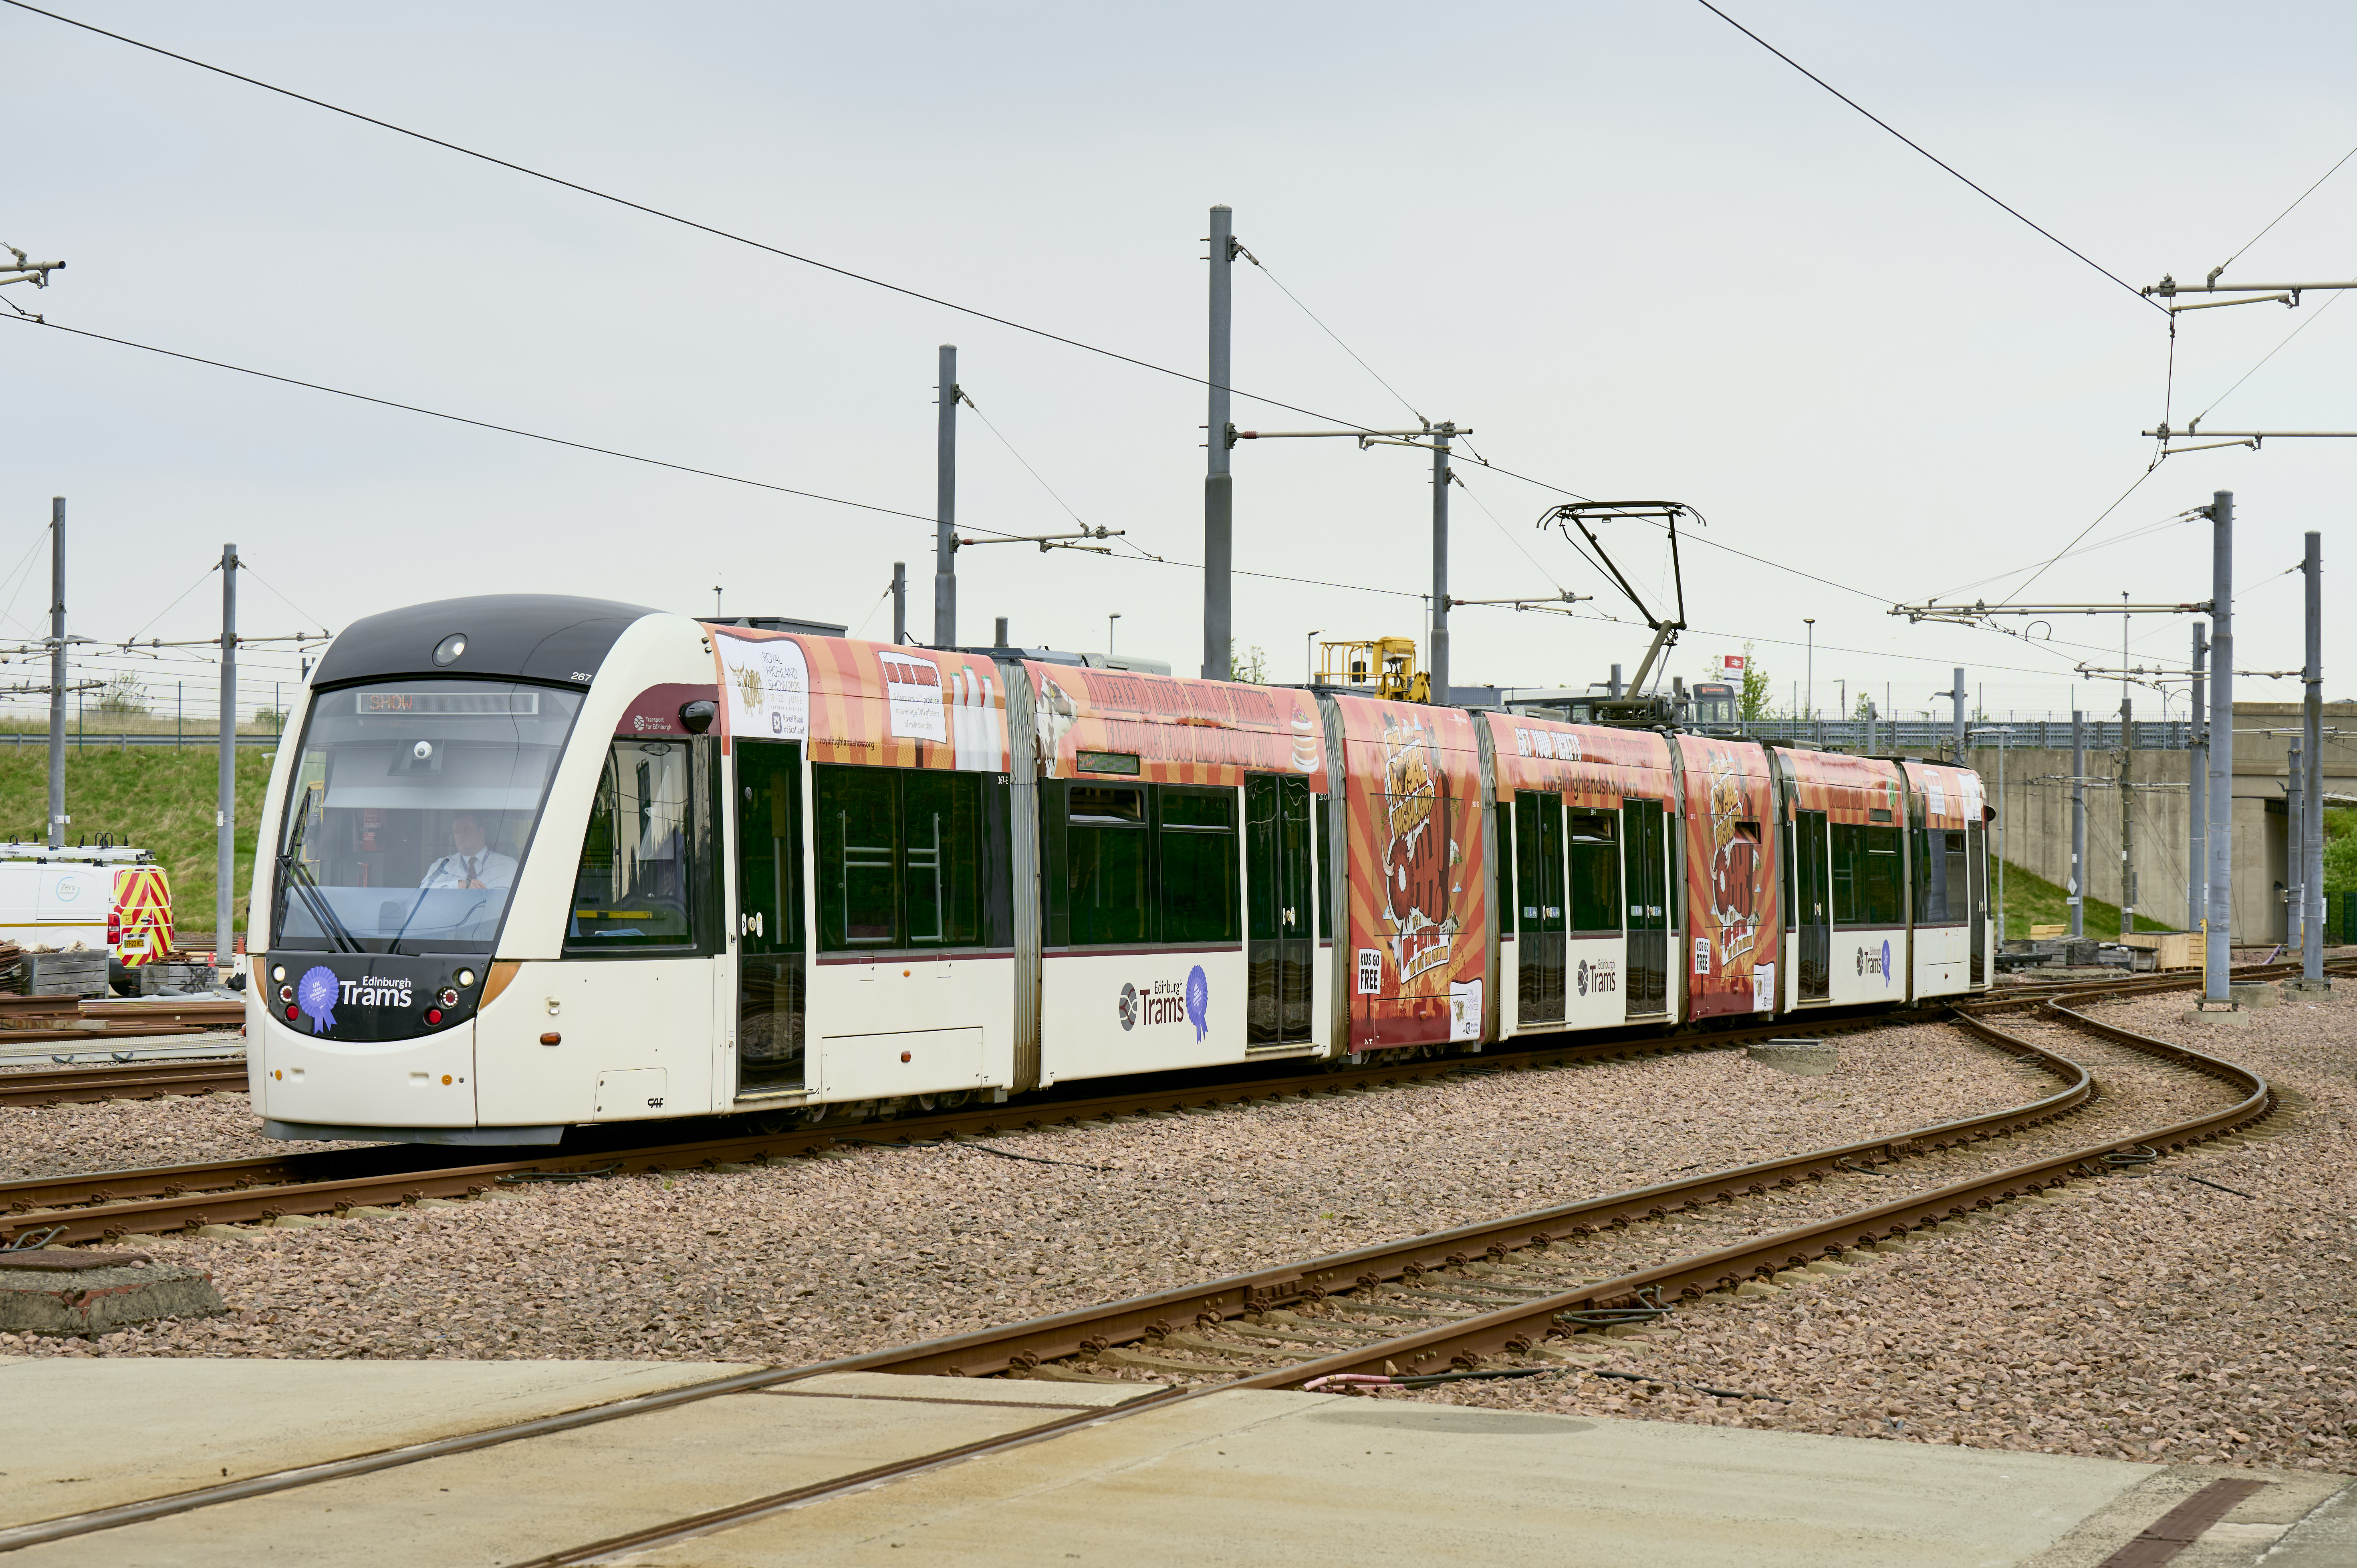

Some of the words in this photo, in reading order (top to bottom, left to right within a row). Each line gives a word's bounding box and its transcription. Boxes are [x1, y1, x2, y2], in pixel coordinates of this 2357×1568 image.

[762, 653, 782, 664] ROYAL
[571, 672, 592, 681] 267
[766, 665, 798, 679] HIGHLAND
[883, 661, 900, 683] DID
[897, 663, 915, 685] EWE
[911, 665, 939, 687] KNOW?
[768, 679, 786, 691] SHOW
[788, 681, 800, 693] 2025
[370, 695, 412, 709] SHOW
[788, 695, 802, 705] JUNE
[897, 694, 907, 703] dairy
[923, 696, 939, 705] produce
[1081, 672, 1100, 710] A
[1092, 673, 1151, 714] WEEKEND
[1145, 678, 1192, 718] THAT'S
[1183, 683, 1218, 721] FULL
[1212, 686, 1232, 722] OF
[1226, 687, 1281, 734] FARMING,
[783, 715, 793, 724] Royal
[926, 709, 940, 718] glasses
[789, 726, 804, 734] Scotland
[926, 722, 934, 732] day.
[819, 736, 874, 751] royalhighlandshow.org
[1104, 717, 1163, 760] FABULOUS
[1162, 722, 1193, 762] FOOD
[1193, 724, 1217, 764] AND
[1216, 726, 1252, 767] FAMILY
[1253, 731, 1275, 769] FUN
[1386, 730, 1402, 759] THE
[1515, 727, 1532, 757] GET
[1529, 728, 1553, 759] YOUR
[1550, 731, 1582, 762] TICKETS
[998, 776, 1008, 784] 267-E
[1389, 744, 1428, 809] ROYAL
[1543, 768, 1638, 800] royalhighlandshow.org
[1391, 785, 1435, 840] HIGHLAND
[1419, 913, 1421, 927] A
[1403, 925, 1440, 971] MOO-MENTOUS
[1704, 942, 1709, 952] GO
[1361, 953, 1371, 966] KIDS
[1373, 954, 1379, 967] GO
[1432, 945, 1448, 964] EVERYONE
[1598, 958, 1615, 971] Edinburgh
[1697, 954, 1708, 971] FREE
[1864, 951, 1881, 974] Trams
[363, 976, 411, 989] Edinburgh
[1361, 969, 1378, 990] FREE
[1590, 965, 1615, 993] Trams
[310, 988, 327, 998] OPERATOR
[340, 980, 412, 1007] Trams
[1155, 979, 1183, 996] Edinburgh
[1193, 982, 1198, 991] UK
[1140, 989, 1184, 1025] Trams
[647, 1098, 663, 1108] CAF
